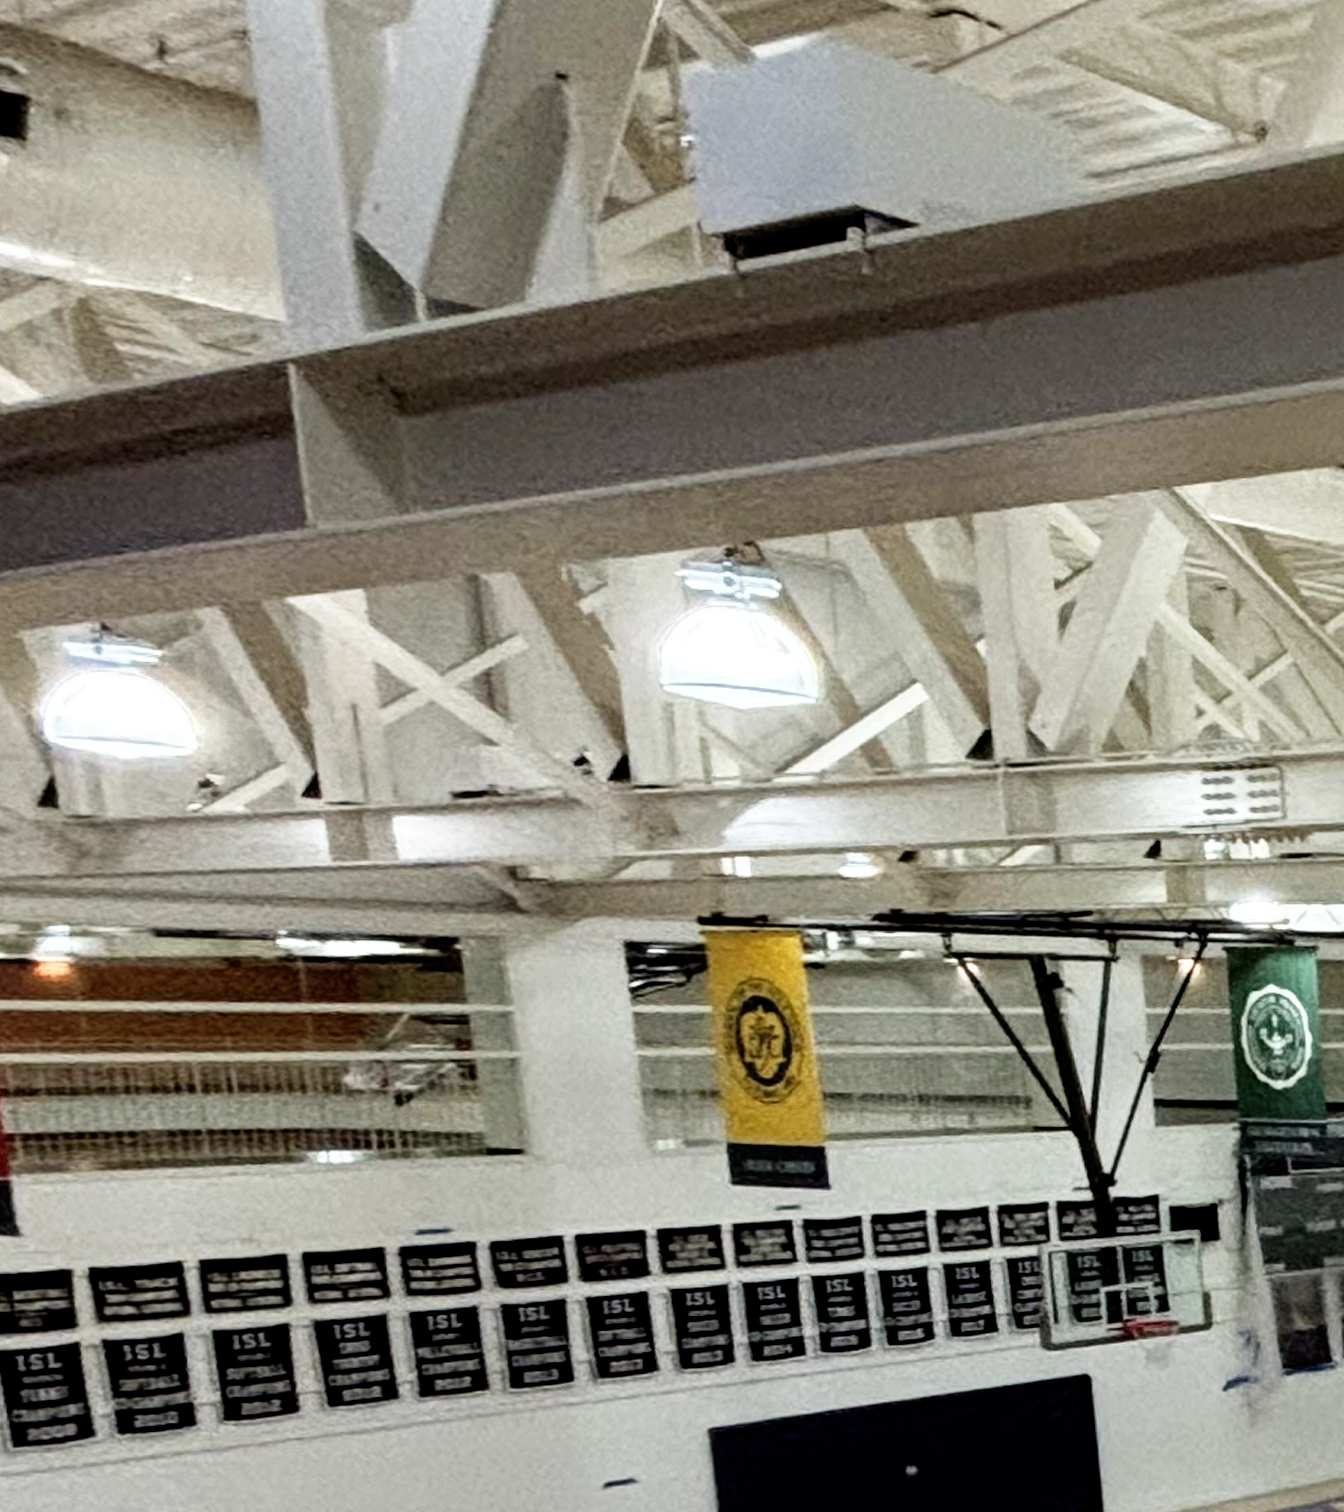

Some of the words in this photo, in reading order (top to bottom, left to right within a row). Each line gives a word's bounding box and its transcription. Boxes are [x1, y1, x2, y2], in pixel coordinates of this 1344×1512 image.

[685, 1291, 716, 1306] ISL
[757, 1285, 786, 1300] ISL
[518, 1306, 550, 1322] ISL
[603, 1299, 635, 1315] ISL
[427, 1313, 463, 1330] ISL
[333, 1322, 371, 1339] ISL
[232, 1332, 272, 1350] ISL
[123, 1342, 167, 1361] ISL
[15, 1352, 63, 1372] ISL
